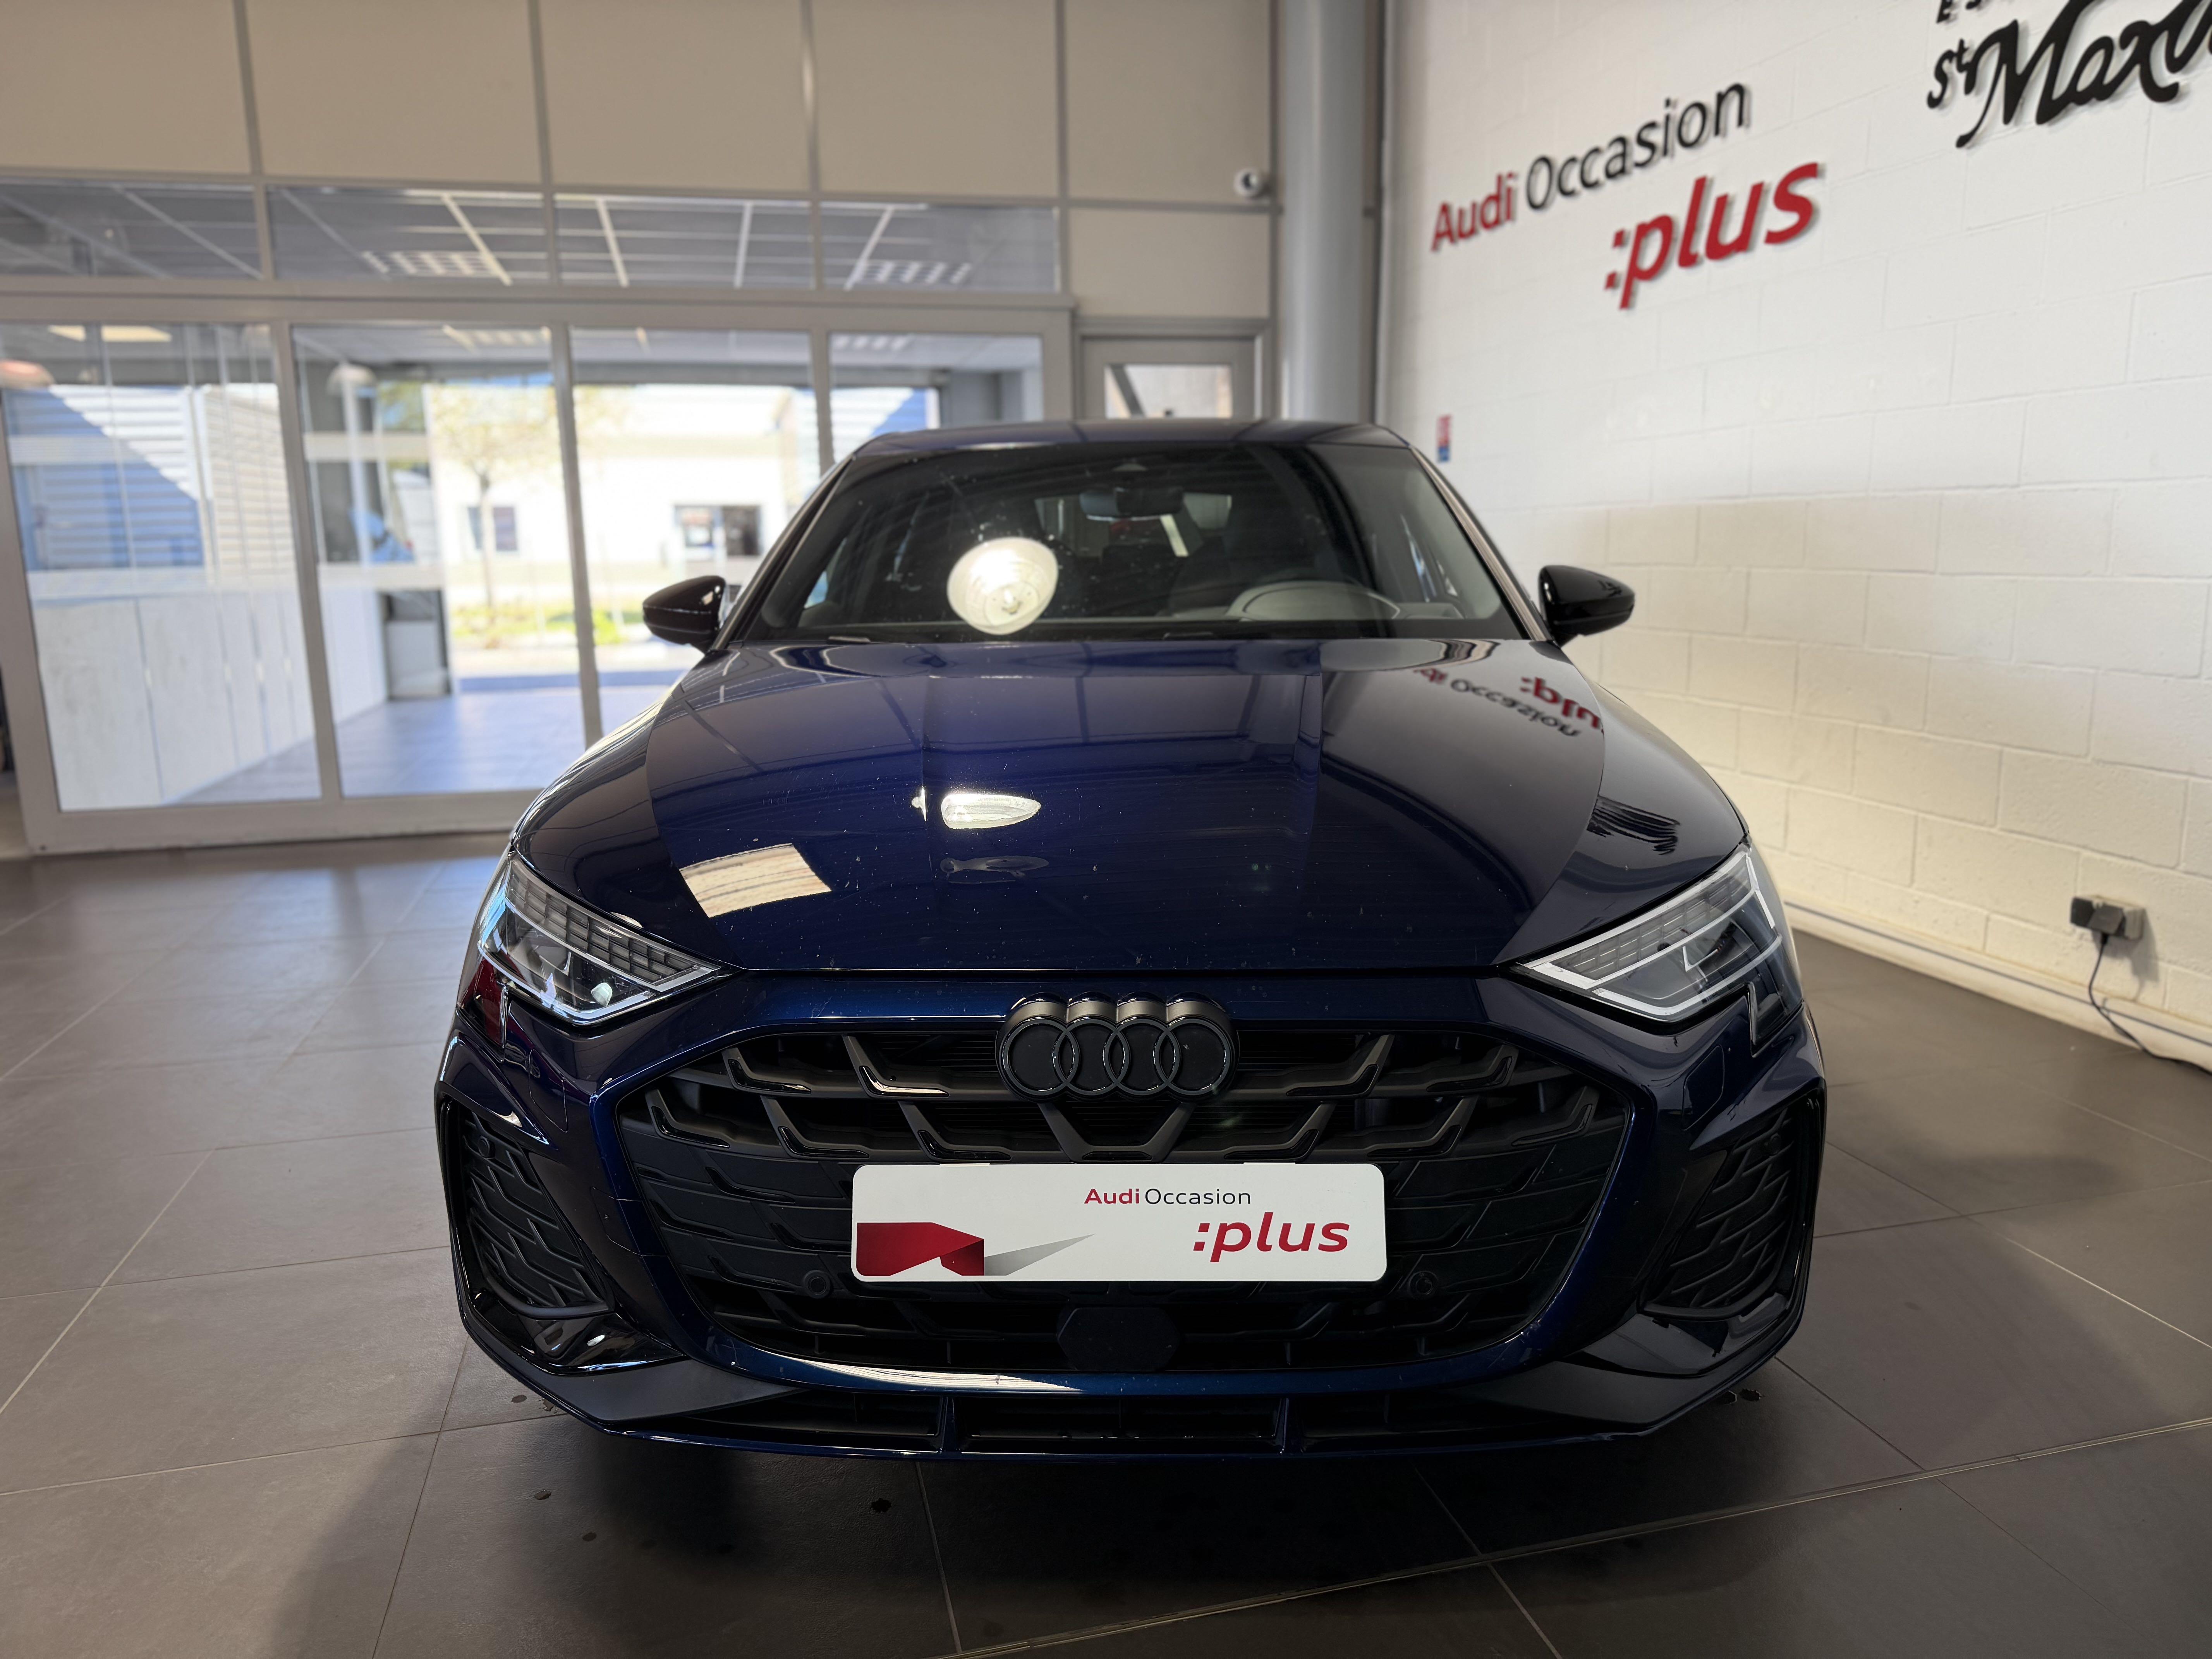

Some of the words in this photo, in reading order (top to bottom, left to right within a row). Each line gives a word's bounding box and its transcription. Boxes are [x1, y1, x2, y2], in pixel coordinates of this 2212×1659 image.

[1431, 172, 1516, 252] Audi
[1526, 83, 1746, 210] Occasion
[1604, 162, 1819, 309] :plus
[1084, 1188, 1140, 1204] Audi
[1145, 1188, 1251, 1205] Occasion
[1194, 1212, 1350, 1263] :plus
